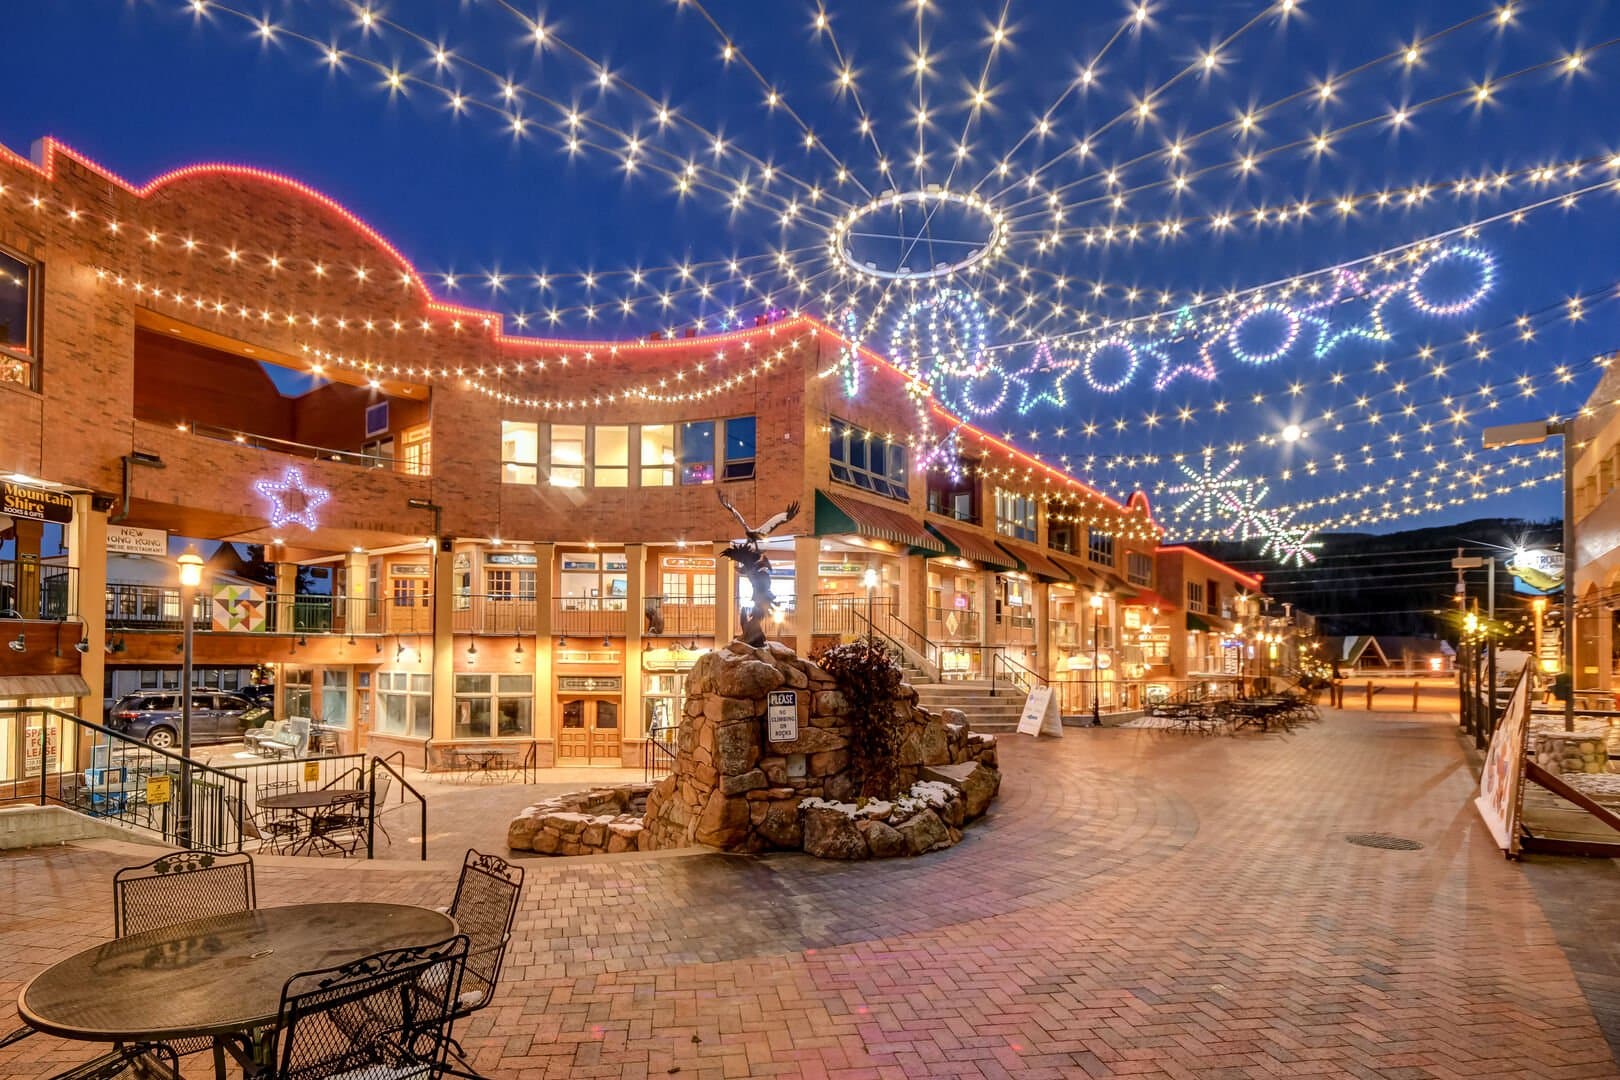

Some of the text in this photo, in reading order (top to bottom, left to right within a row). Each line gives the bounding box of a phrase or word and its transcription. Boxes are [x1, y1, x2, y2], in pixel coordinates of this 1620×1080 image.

[4, 483, 72, 507] Mountain
[4, 495, 45, 513] Shire
[4, 506, 23, 515] BOOKS
[29, 511, 45, 519] GIFTS
[121, 528, 144, 537] NEW
[135, 538, 161, 547] KONG
[771, 694, 793, 704] PLEASE
